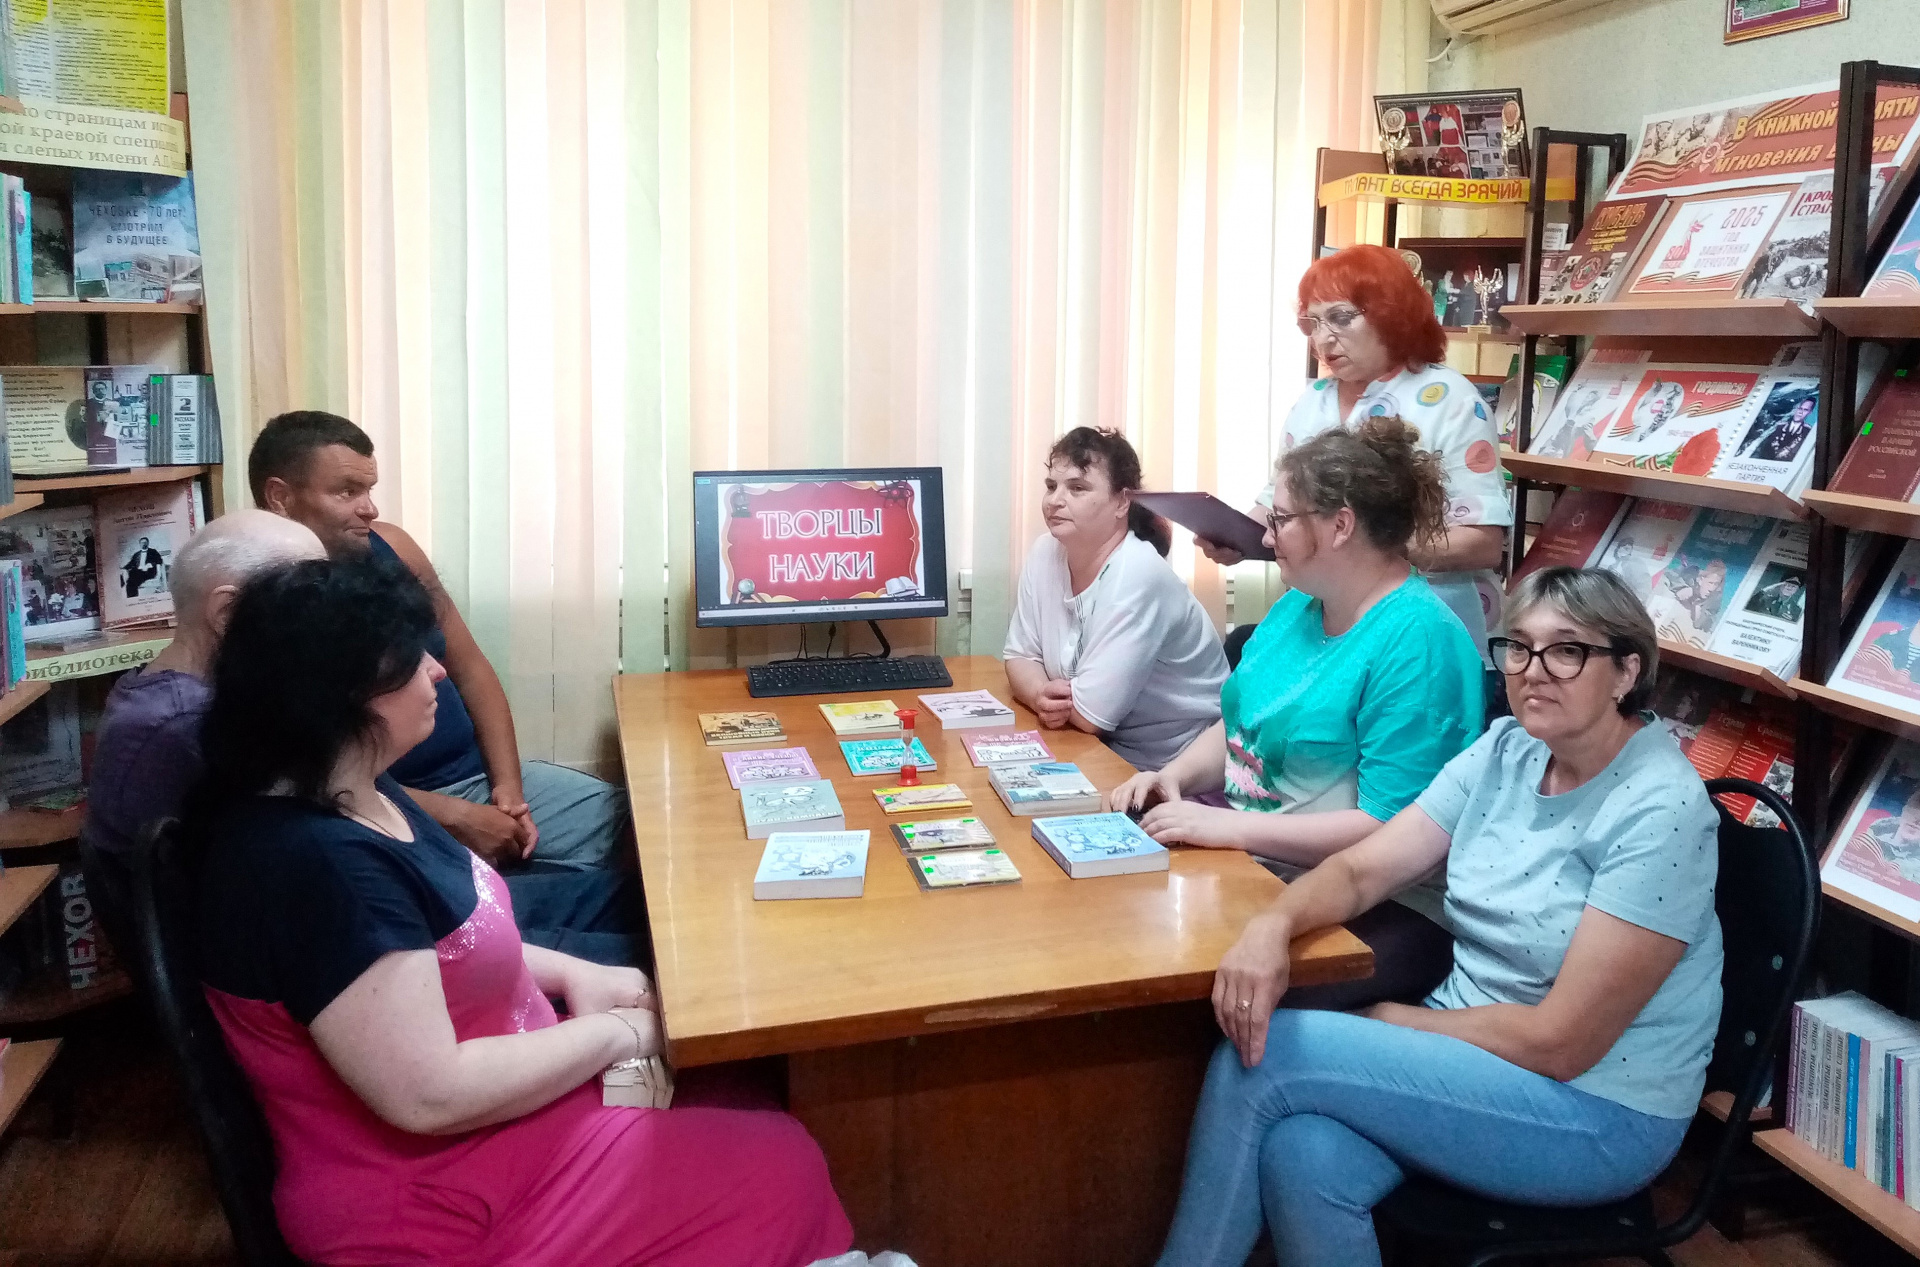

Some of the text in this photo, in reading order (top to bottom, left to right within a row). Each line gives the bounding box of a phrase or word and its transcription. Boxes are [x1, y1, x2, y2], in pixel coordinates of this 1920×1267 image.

[45, 109, 147, 130] страницам
[1733, 117, 1749, 141] В
[30, 126, 108, 143] краевой
[14, 143, 83, 159] слепых
[87, 151, 148, 166] имени
[1391, 178, 1452, 199] ВСЕГДА
[1457, 180, 1522, 200] ЗРЯЧИЙ
[149, 205, 161, 217] 70
[1721, 205, 1768, 229] 2025
[111, 222, 163, 232] СМОТРИМ
[106, 235, 168, 246] В БУДУЩЕЕ
[179, 398, 191, 411] 2
[756, 508, 882, 539] ТВОРЦЫ
[769, 552, 875, 583] НАУКИ
[60, 873, 98, 990] ЧЕХОВ
